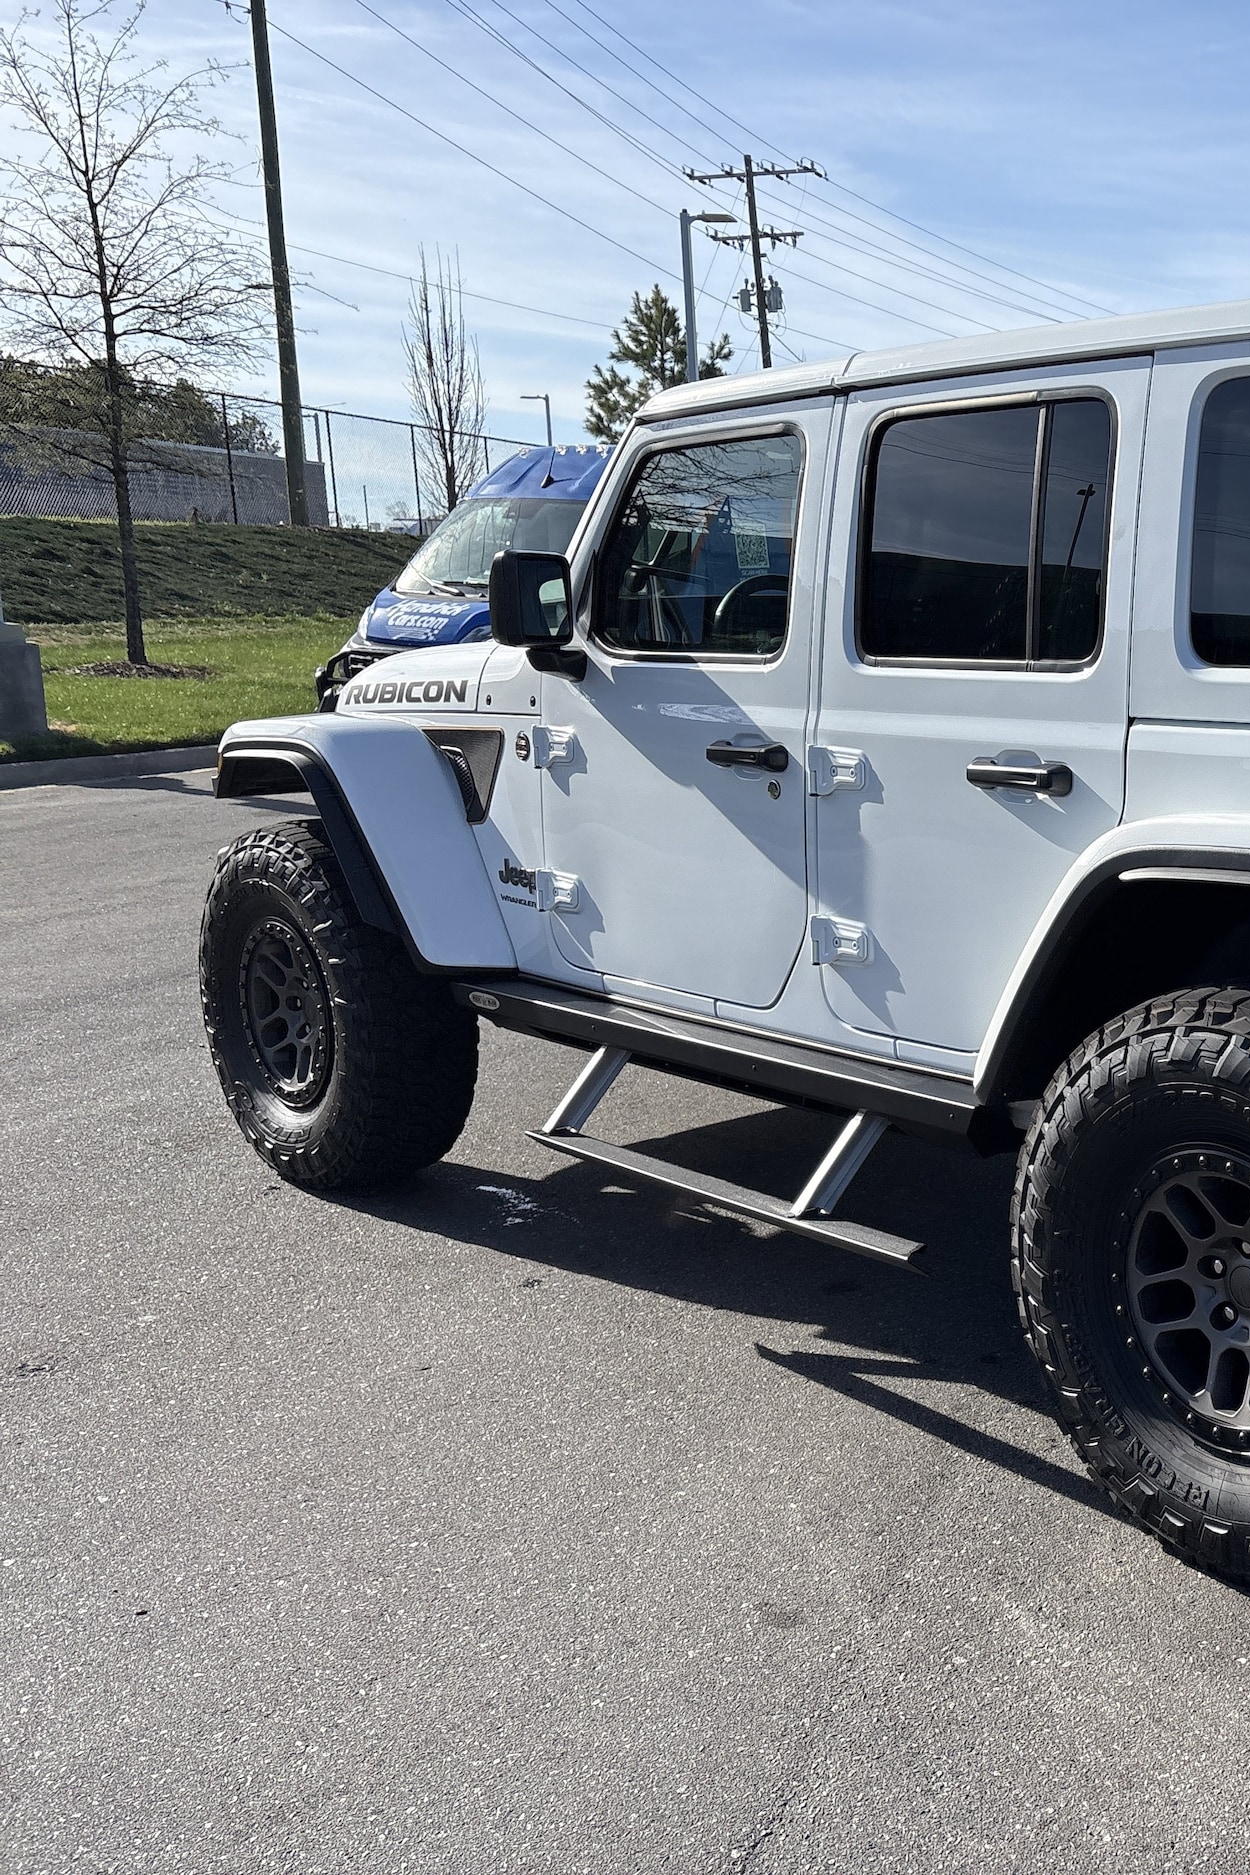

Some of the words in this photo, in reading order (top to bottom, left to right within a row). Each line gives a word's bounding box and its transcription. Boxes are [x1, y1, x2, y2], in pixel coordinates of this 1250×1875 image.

[345, 680, 469, 706] RUBICON
[499, 858, 537, 895] Jeep
[500, 893, 538, 908] WRANGLER
